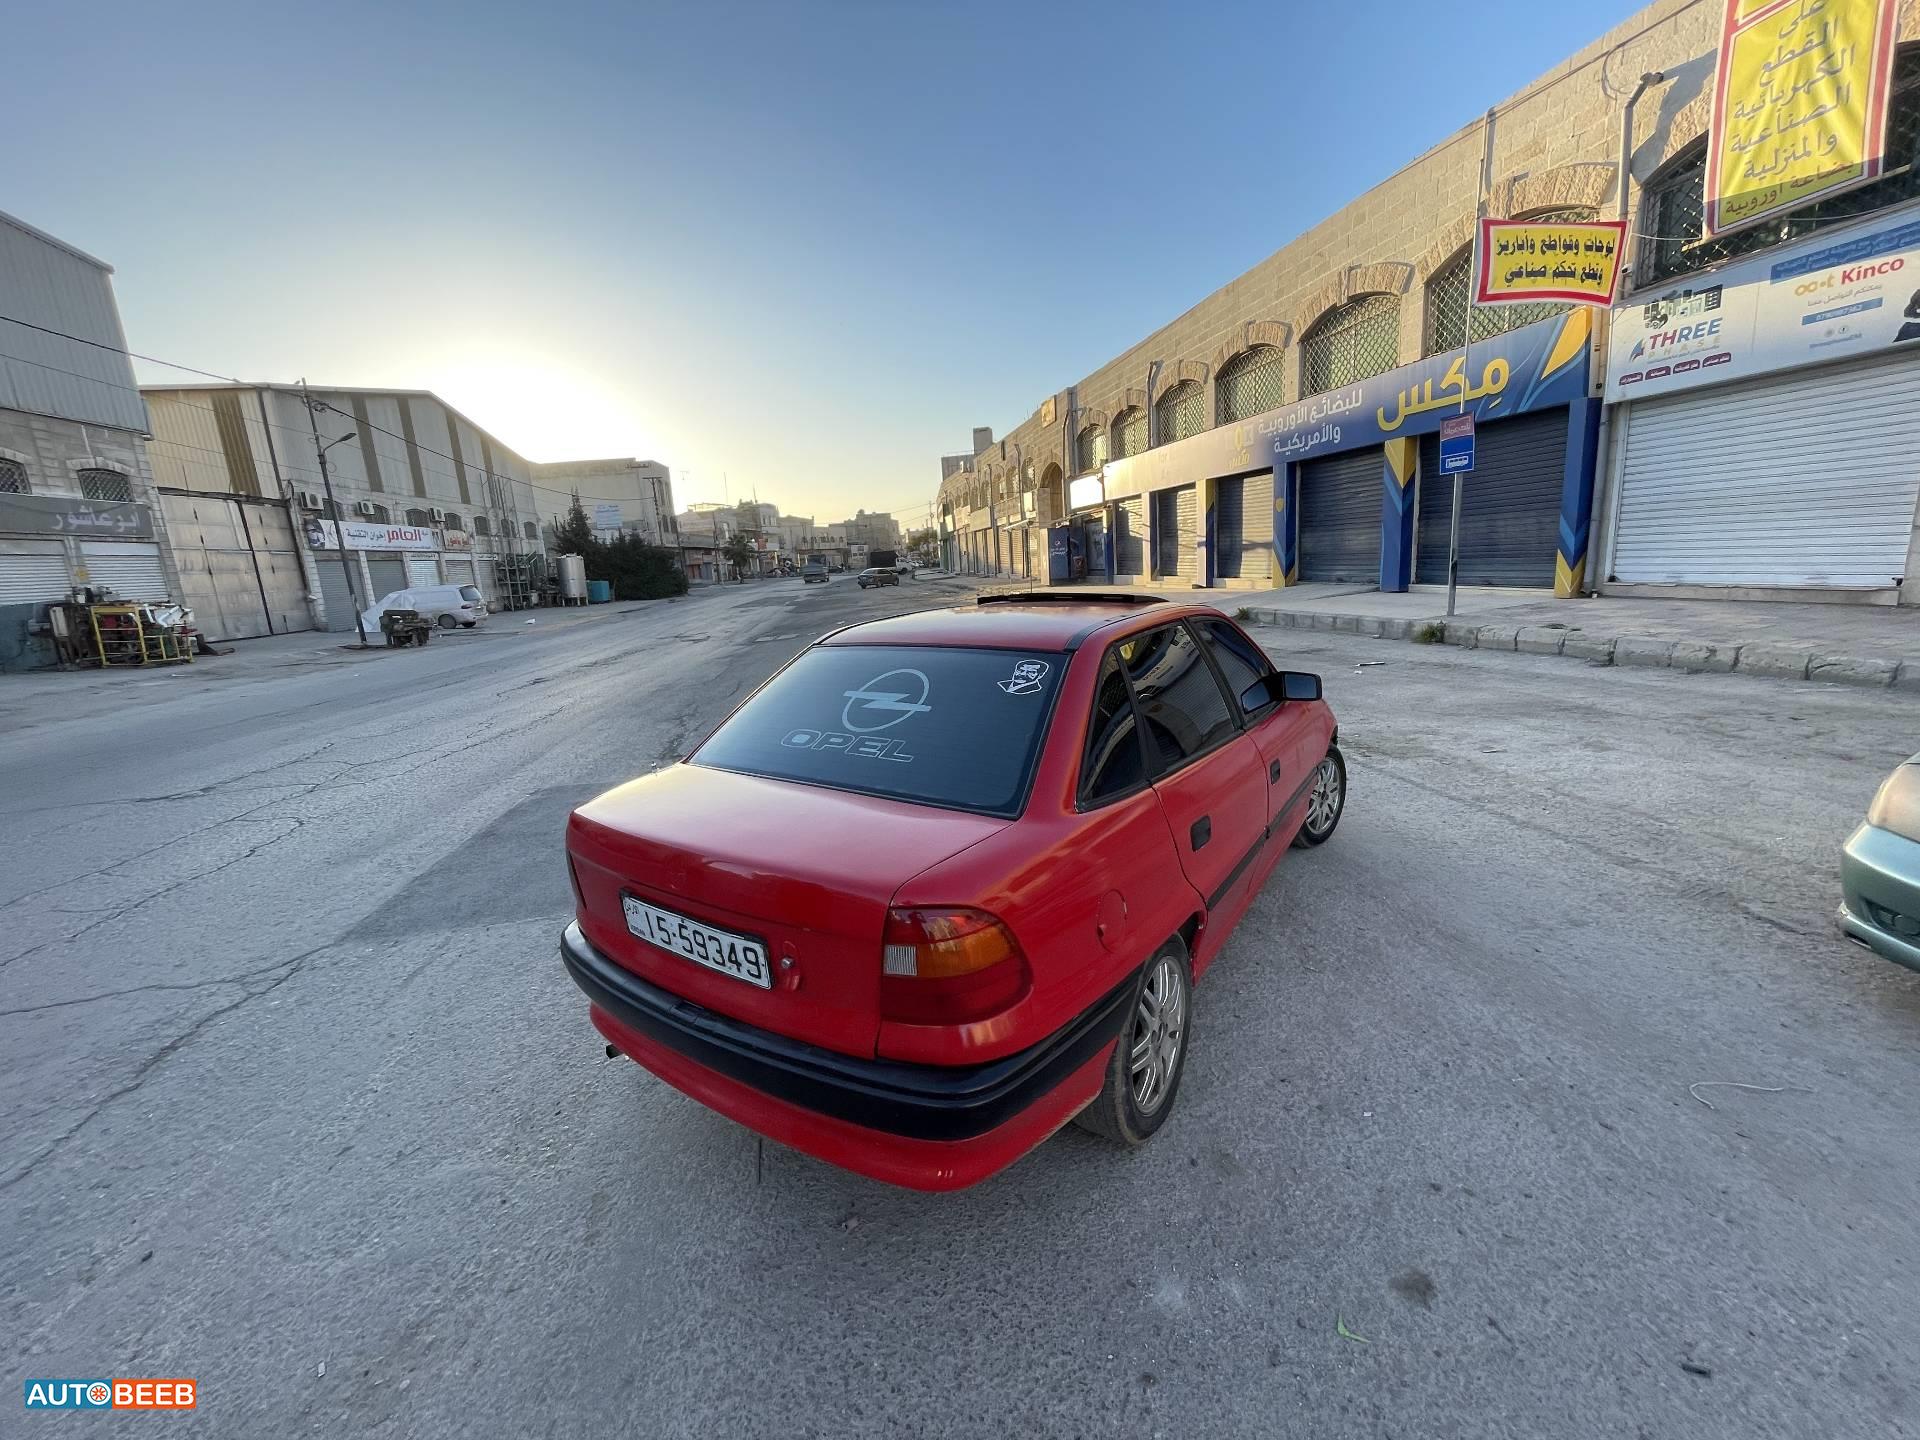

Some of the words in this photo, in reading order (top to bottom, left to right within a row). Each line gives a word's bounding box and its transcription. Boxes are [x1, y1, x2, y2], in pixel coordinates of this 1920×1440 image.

[1760, 16, 1838, 87] القطع
[1731, 83, 1850, 154] الصناعية
[1540, 233, 1580, 256] وقواطع
[1584, 234, 1615, 257] لوحات
[1504, 261, 1547, 287] صناعي
[1841, 258, 1905, 285] Kinco
[1649, 317, 1723, 350] THREE
[1258, 406, 1308, 437] الأوروبية
[1309, 388, 1363, 424] للبضائع
[1274, 423, 1341, 455] والأمريكية
[780, 729, 915, 762] OPEL
[644, 911, 762, 979] 15-59349
